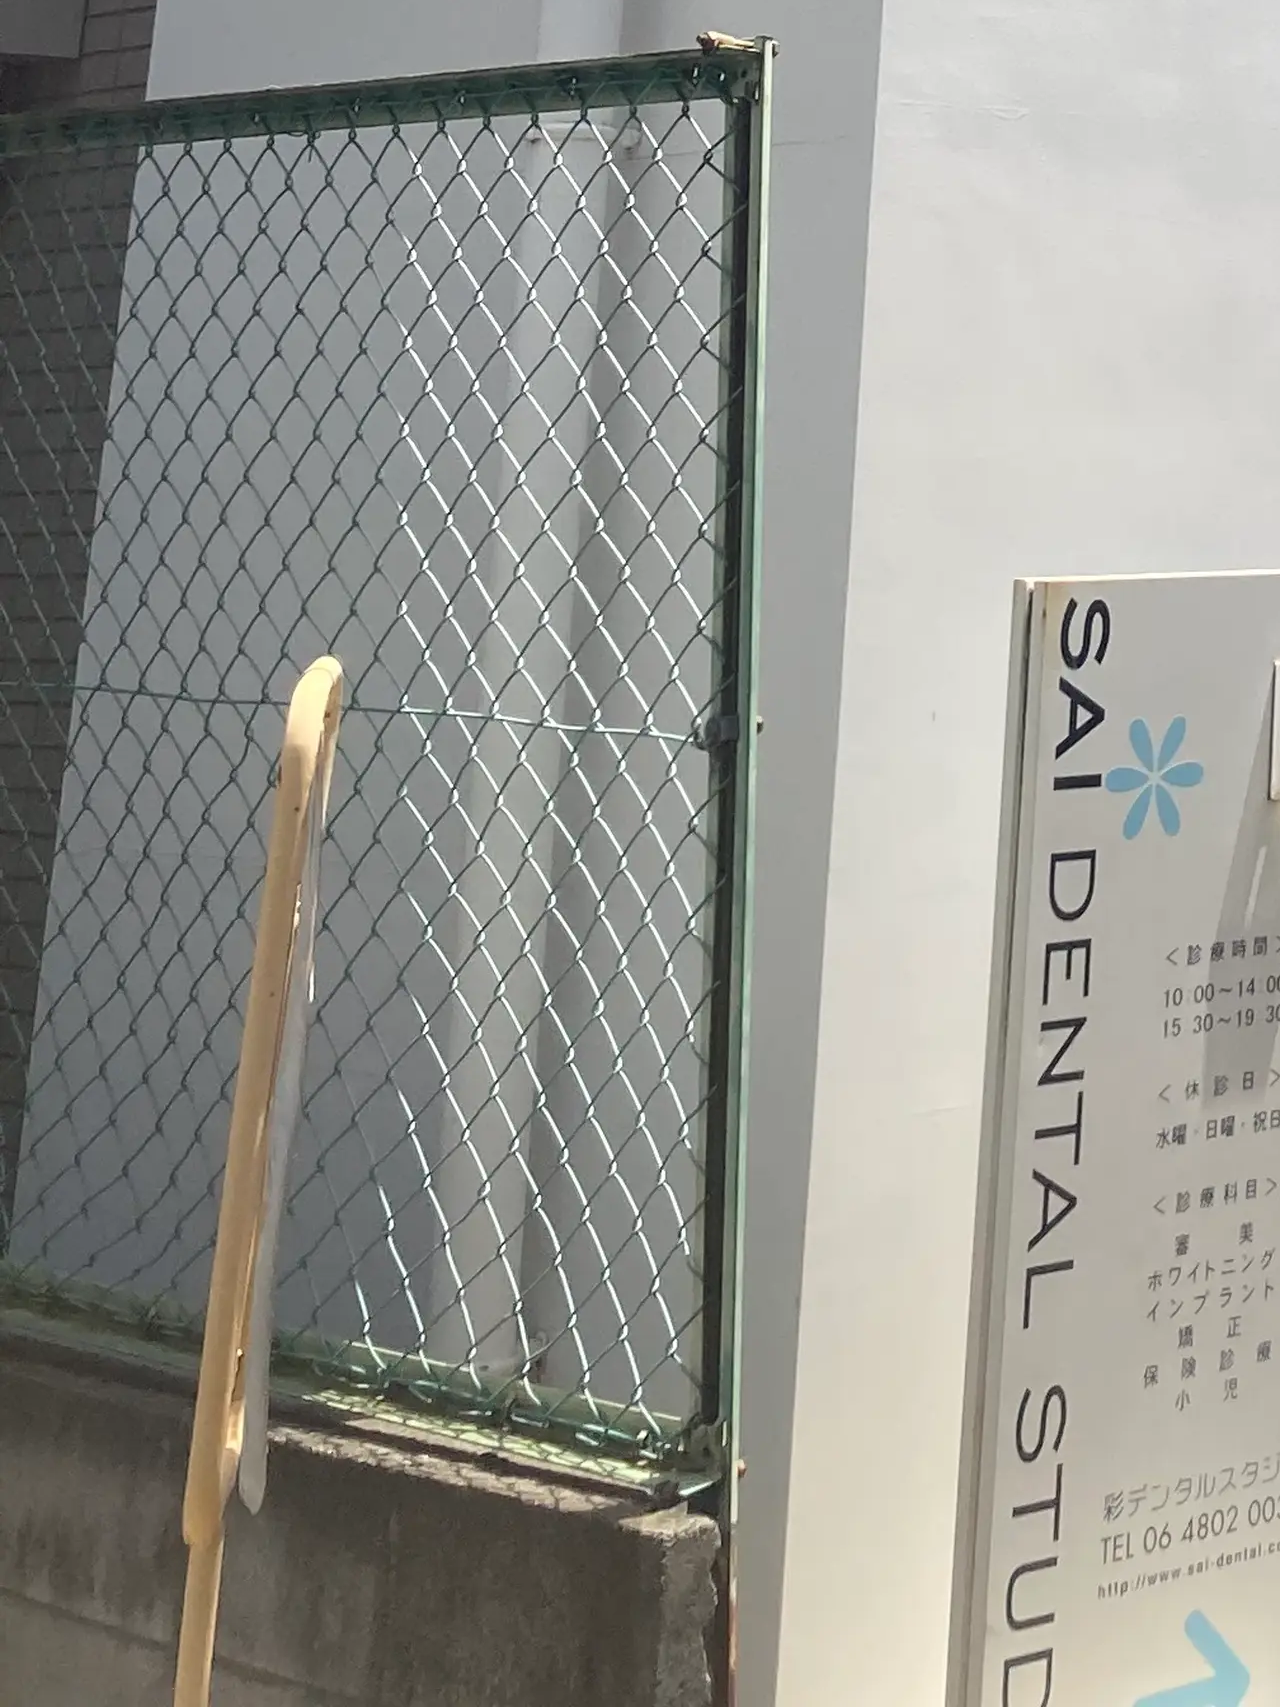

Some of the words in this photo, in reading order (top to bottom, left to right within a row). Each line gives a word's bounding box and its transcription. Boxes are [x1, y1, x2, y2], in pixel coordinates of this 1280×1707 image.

[1053, 598, 1111, 792] SAI
[1022, 849, 1097, 1330] DENTAL
[1147, 1247, 1276, 1292] ホワイトニング
[1146, 1279, 1275, 1322] インプラント
[1100, 1531, 1134, 1565] TEL
[1143, 1522, 1172, 1554] 06
[1180, 1505, 1239, 1544] 4802
